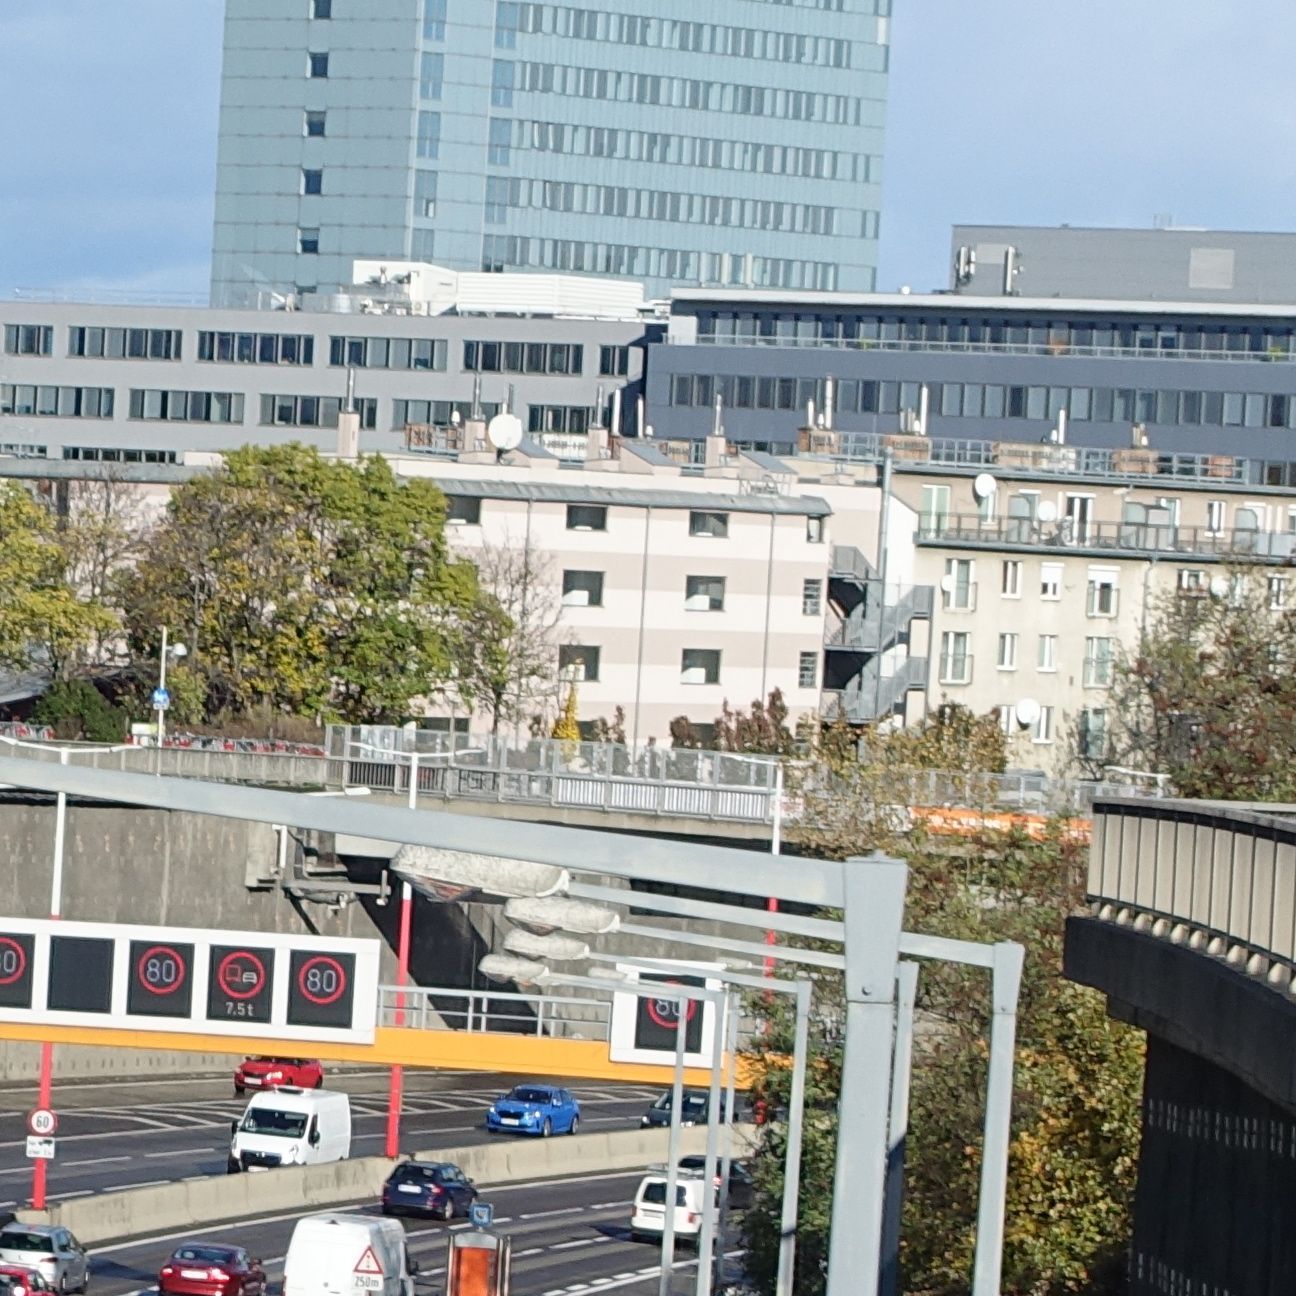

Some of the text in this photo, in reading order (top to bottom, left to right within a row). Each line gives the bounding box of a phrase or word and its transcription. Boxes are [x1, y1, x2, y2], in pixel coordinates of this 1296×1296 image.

[146, 958, 176, 983] 80
[307, 968, 337, 993] 80
[36, 1116, 49, 1128] 60
